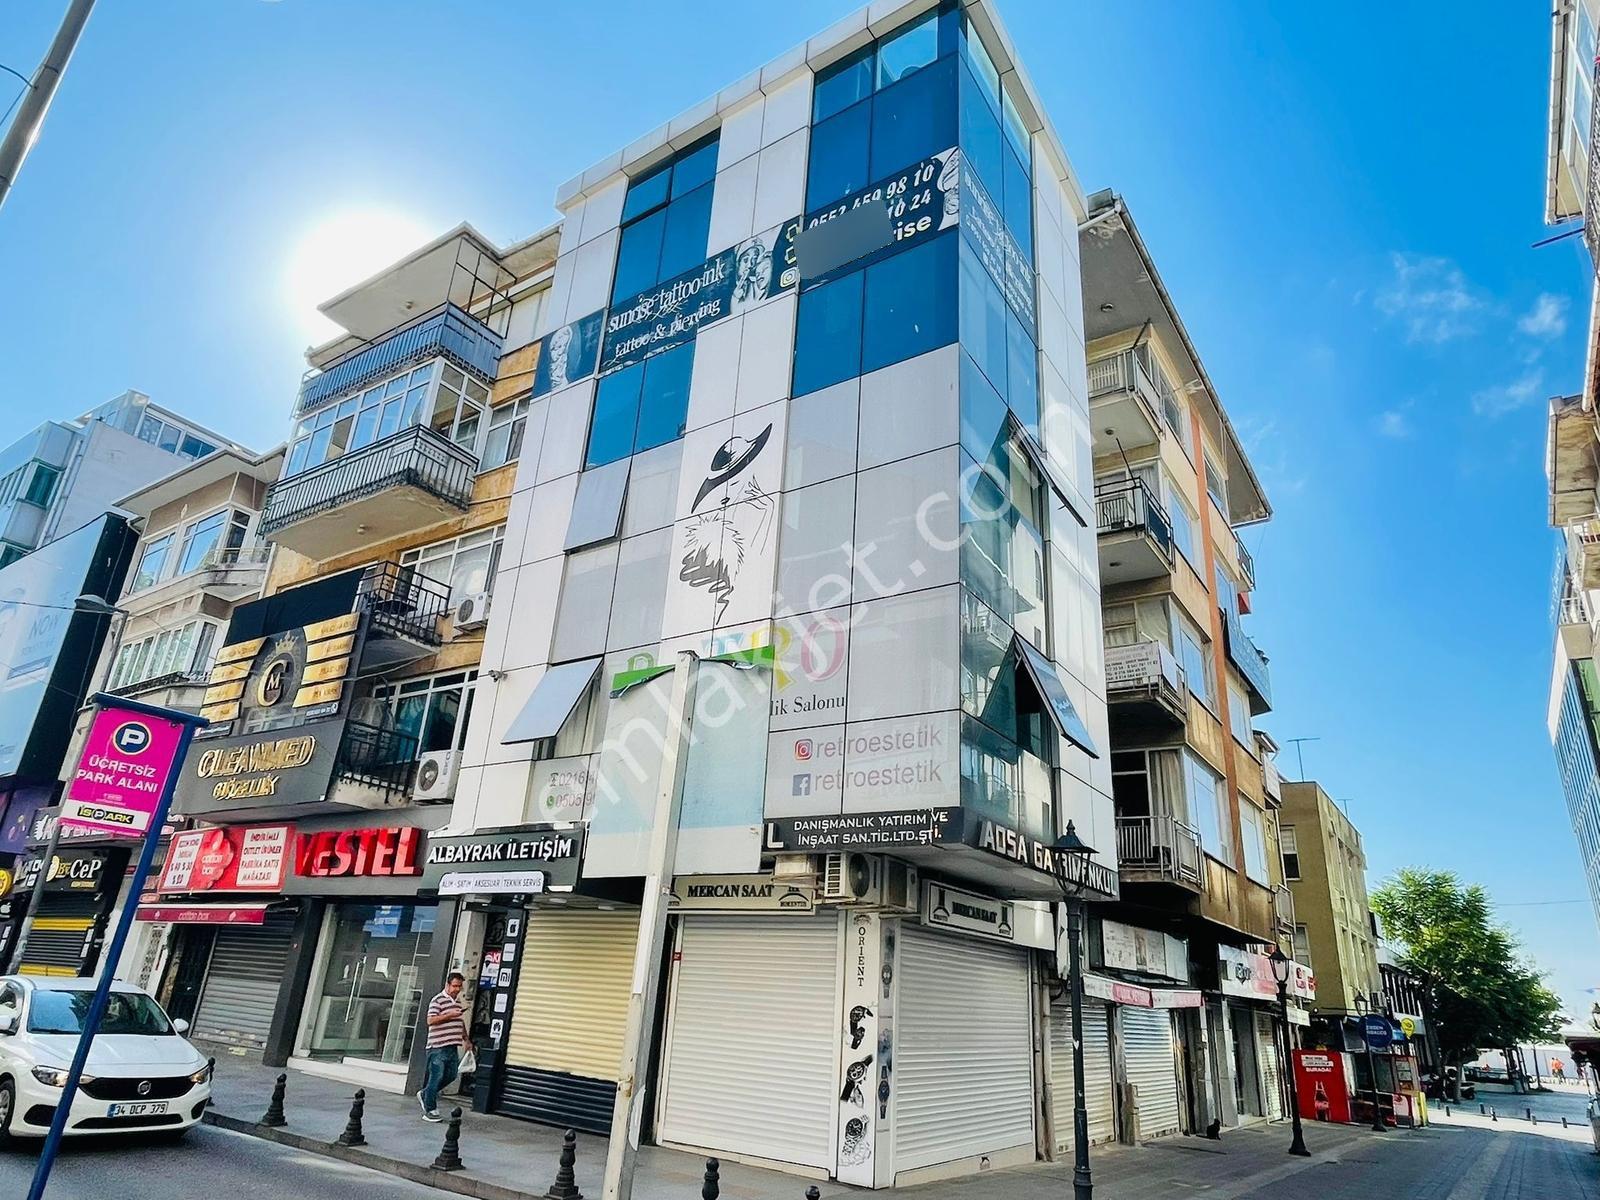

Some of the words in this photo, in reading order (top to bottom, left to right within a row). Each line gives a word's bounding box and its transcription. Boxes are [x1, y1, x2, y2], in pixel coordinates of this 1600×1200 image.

[886, 176, 908, 199] 98
[913, 161, 936, 187] 10
[909, 188, 931, 211] 24
[894, 216, 932, 241] ise
[660, 278, 700, 308] tattoo
[701, 258, 725, 287] ink
[668, 298, 721, 337] piercing
[793, 693, 845, 713] Salonu
[816, 724, 943, 759] retroestetik
[88, 754, 156, 778] ÜCRETSİZ
[815, 759, 941, 791] retroestetik
[76, 769, 115, 786] PARK
[117, 778, 158, 793] ALANI
[794, 817, 874, 833] DANIŞMANLIK
[879, 813, 926, 826] YATIRIM
[932, 811, 949, 822] VE
[296, 827, 422, 877] VESTEL
[427, 843, 502, 864] ALBAYRAK
[506, 835, 572, 863] İLETİŞİM
[798, 832, 839, 849] İNŞAAT
[70, 860, 102, 878] CeP
[687, 884, 741, 898] MERCAN
[741, 884, 774, 898] SAAT
[858, 926, 866, 987] ORIENT
[115, 1104, 126, 1115] 34
[150, 1102, 166, 1114] 379
